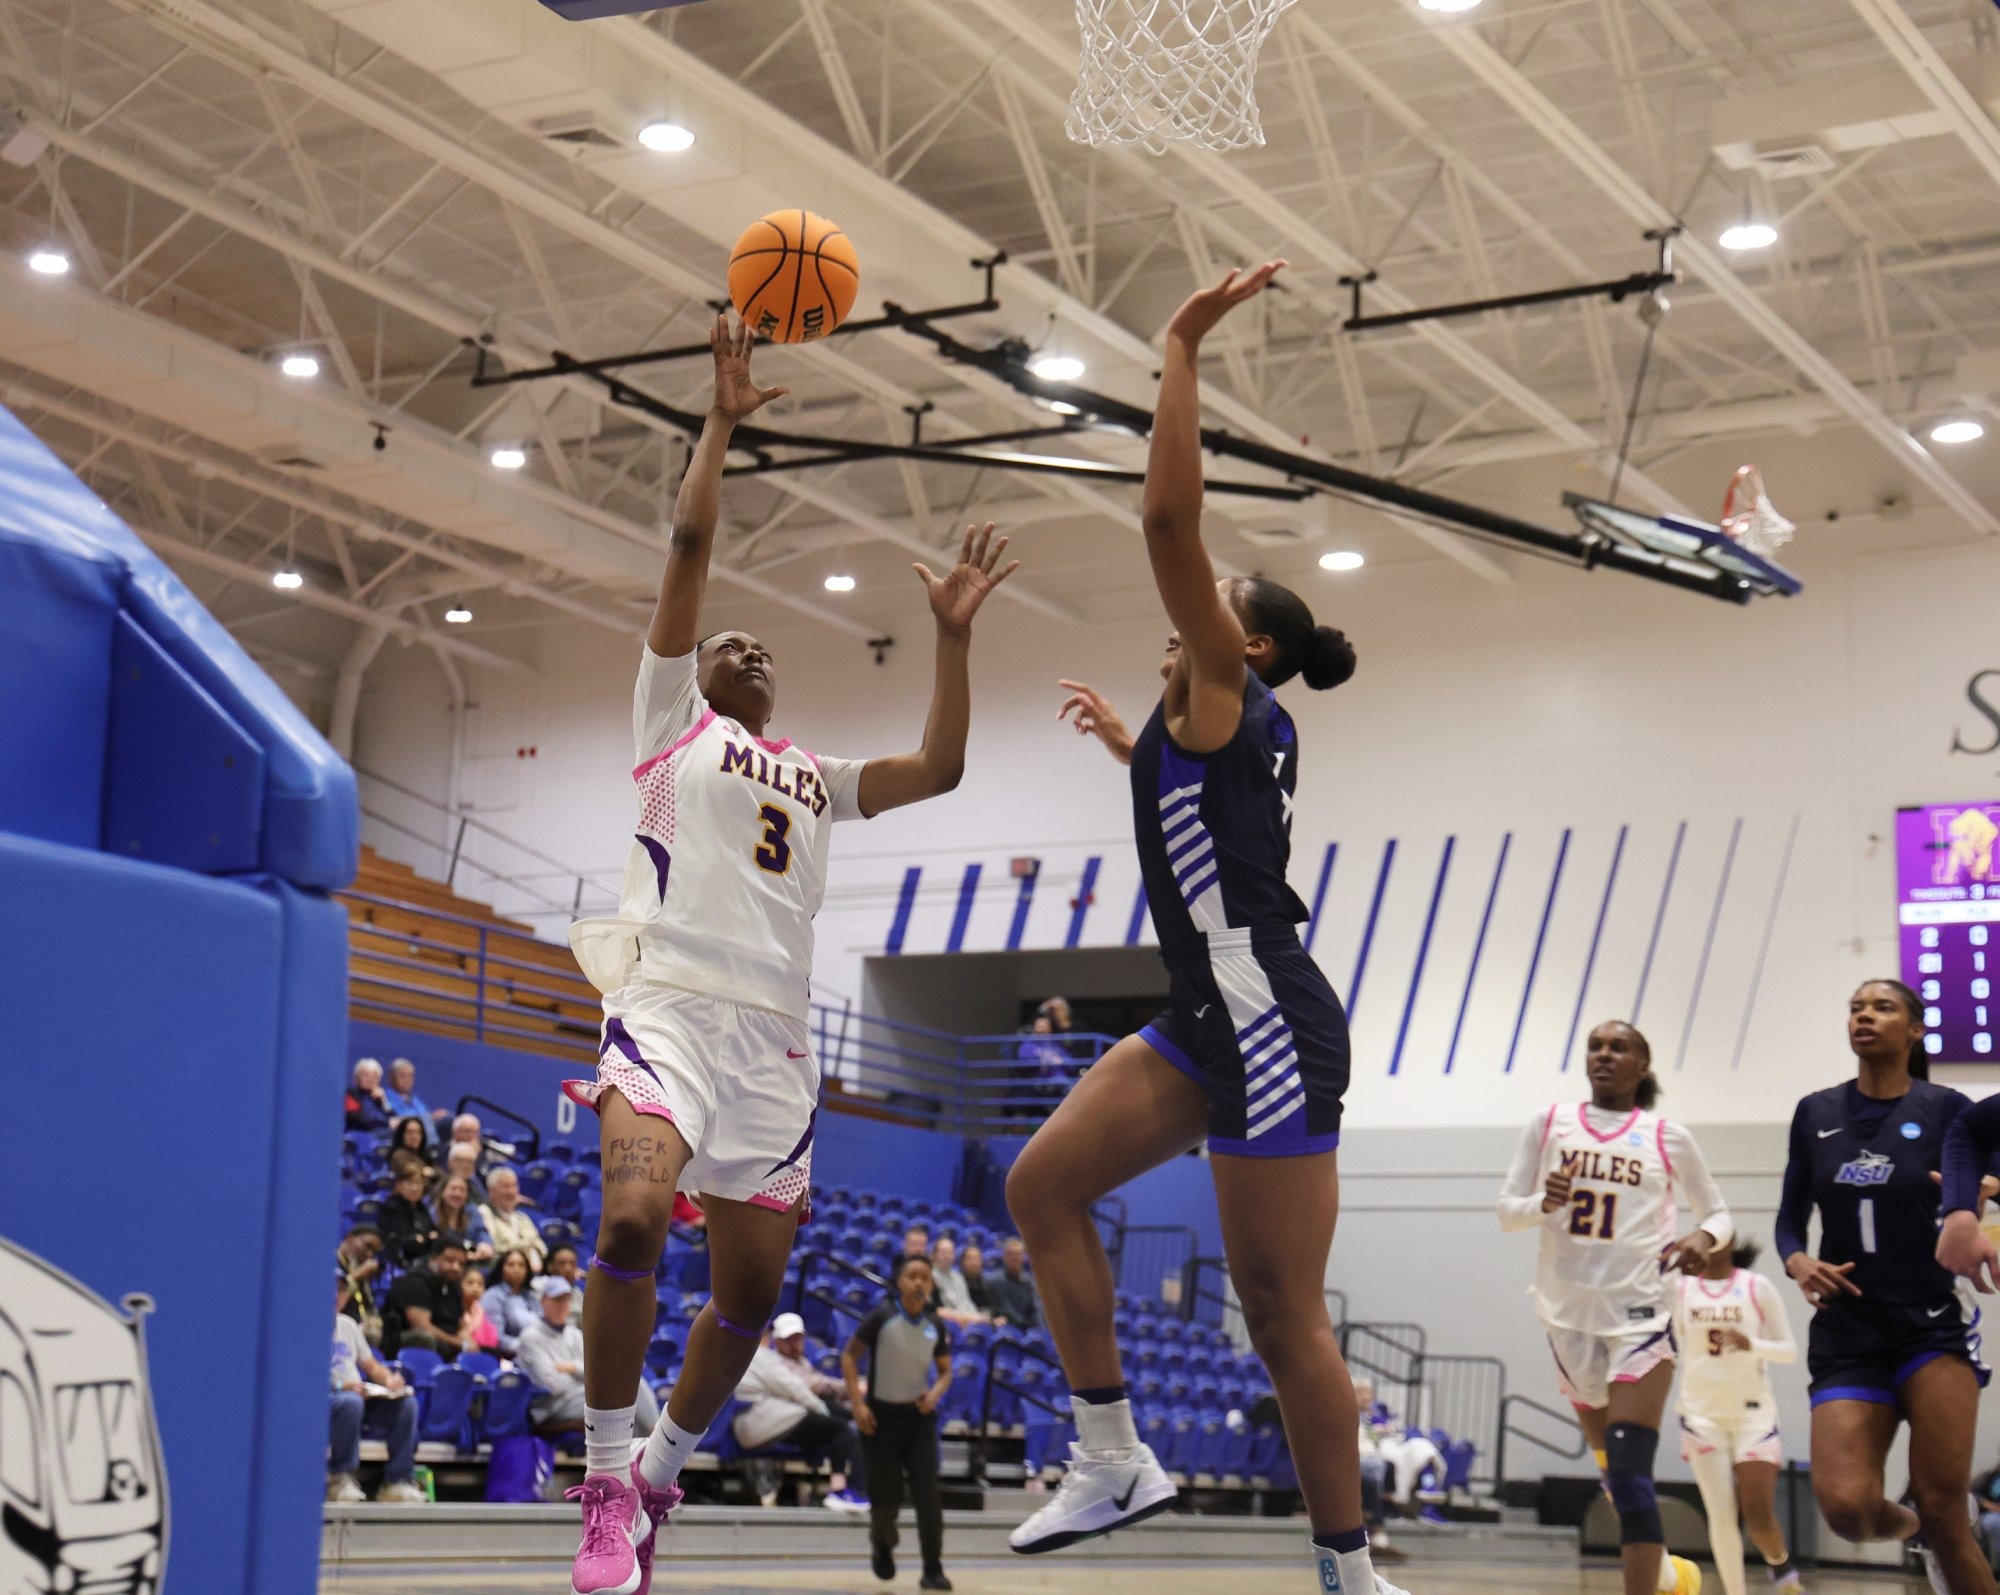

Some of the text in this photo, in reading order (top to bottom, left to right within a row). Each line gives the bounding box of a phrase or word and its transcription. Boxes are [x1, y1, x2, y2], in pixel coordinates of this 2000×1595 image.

[719, 740, 829, 819] MILES
[753, 801, 793, 877] 3
[557, 1092, 577, 1134] D
[610, 1136, 667, 1157] FUCK
[1838, 1164, 1891, 1185] NSU
[1568, 1188, 1618, 1241] 21
[1858, 1198, 1877, 1254] 1
[1690, 1304, 1743, 1323] MILES
